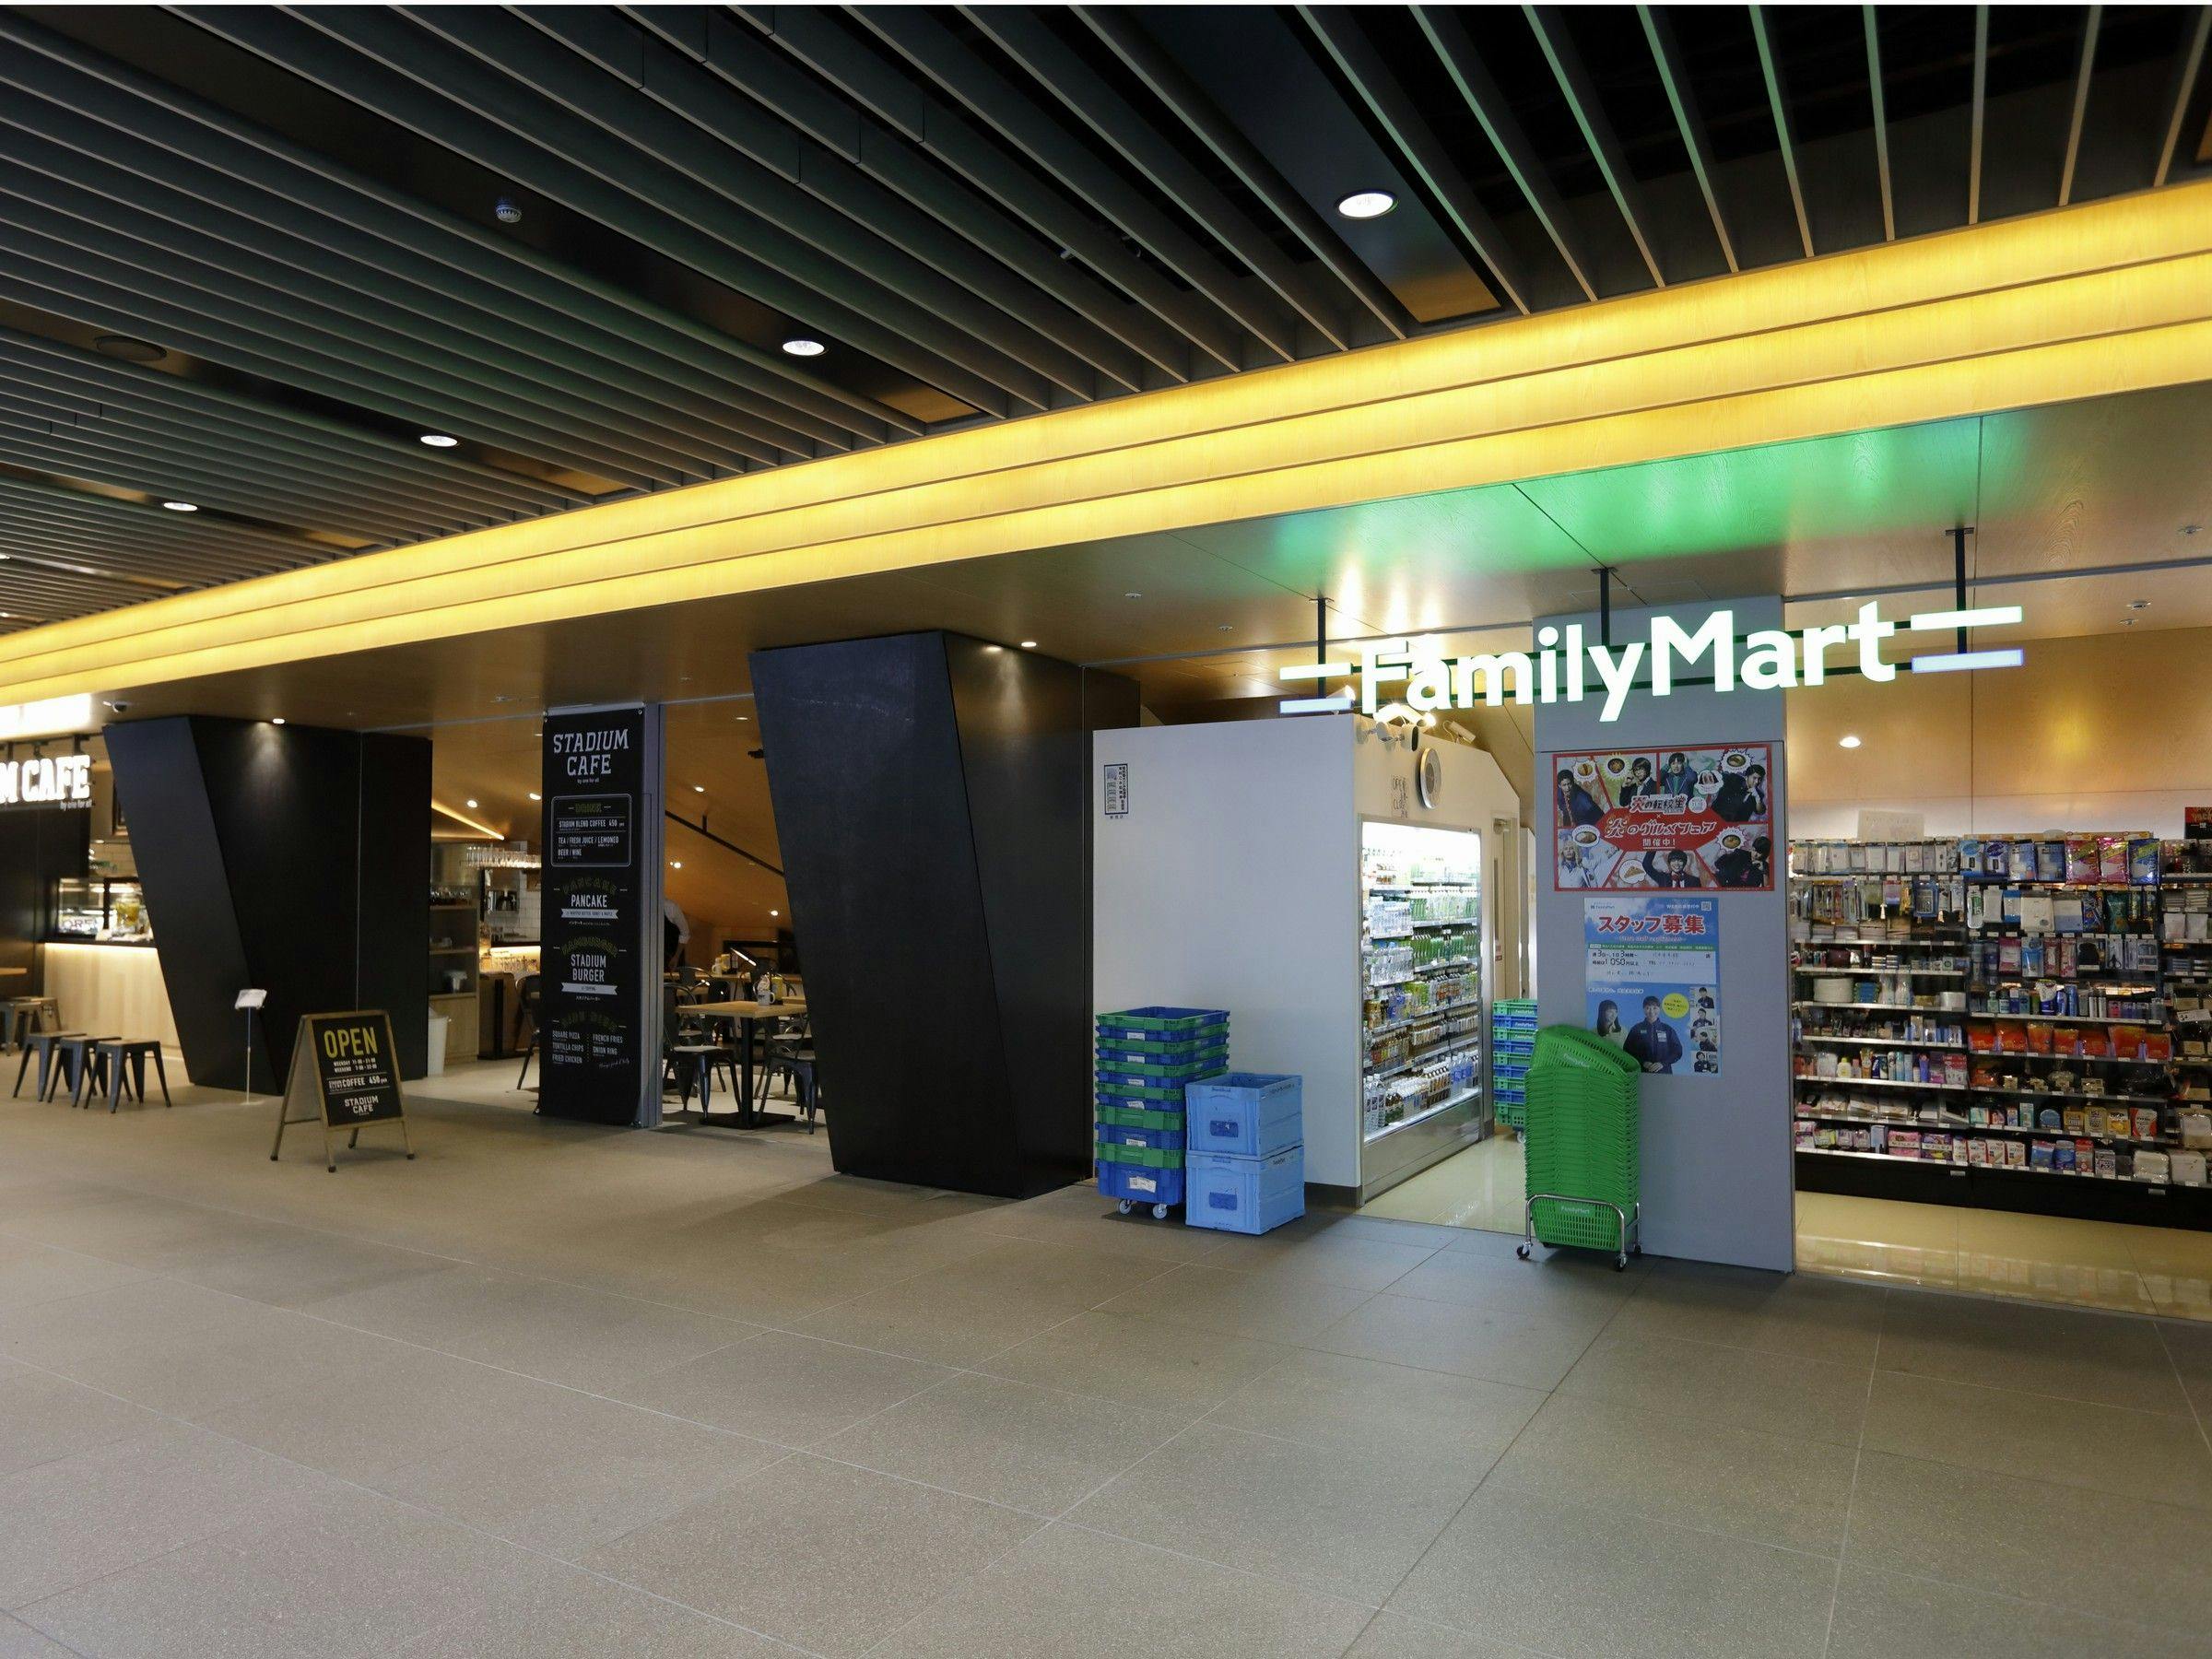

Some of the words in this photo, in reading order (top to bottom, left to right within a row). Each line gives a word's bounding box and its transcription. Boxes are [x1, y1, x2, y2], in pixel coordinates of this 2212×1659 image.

[1361, 600, 1897, 723] FamilyMart
[553, 728, 629, 754] STADIUM
[567, 754, 612, 776] CAFE
[21, 754, 90, 802] CAFE
[559, 819, 575, 829] STADIUM
[575, 819, 589, 828] BLEND
[589, 818, 606, 828] COFFEE
[582, 836, 594, 844] JUICE
[571, 848, 582, 856] WINE
[571, 894, 608, 908] PANCAKE
[1597, 914, 1706, 935] スタッフ募集
[571, 954, 606, 969] STADIUM
[572, 967, 605, 982] BURGER
[569, 1031, 581, 1040] PIZZA
[593, 1033, 610, 1042] FRENCH
[610, 1035, 623, 1043] FRIES
[324, 1027, 379, 1059] OPEN
[552, 1041, 571, 1051] TORTILLA
[571, 1043, 584, 1053] CHIPS
[593, 1046, 606, 1054] ONION
[606, 1047, 618, 1055] RING
[552, 1053, 565, 1063] FRIED
[565, 1055, 582, 1064] CHICKEN
[342, 1077, 366, 1088] COFFEE
[369, 1075, 381, 1085] 450
[344, 1095, 379, 1107] STADIUM
[352, 1104, 374, 1113] CAFE
[1560, 1206, 1590, 1215] FamilyMart
